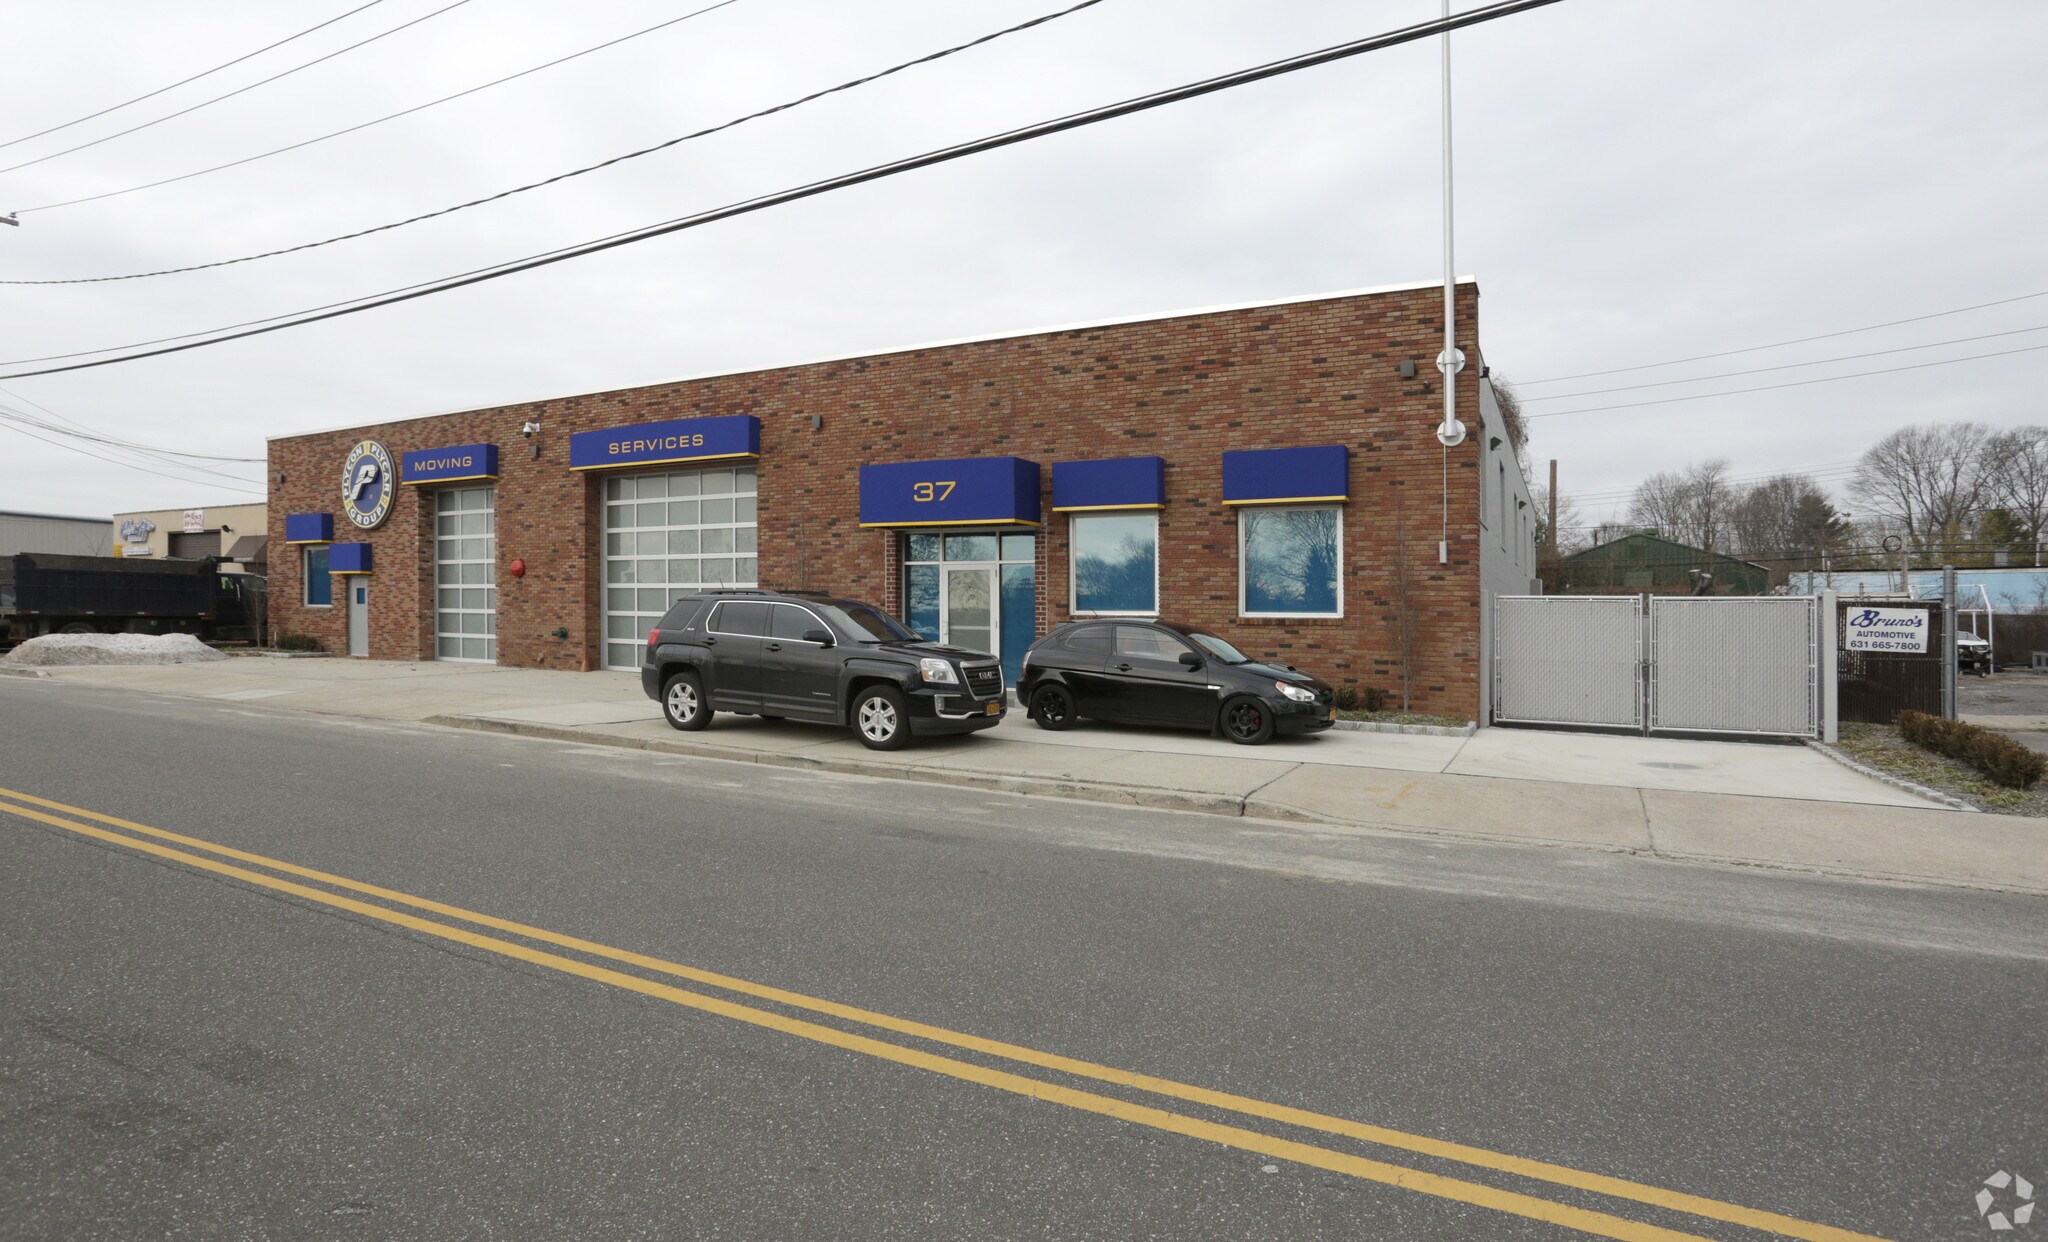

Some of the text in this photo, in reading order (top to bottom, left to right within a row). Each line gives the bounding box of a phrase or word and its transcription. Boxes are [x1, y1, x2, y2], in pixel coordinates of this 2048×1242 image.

[608, 433, 704, 455] SERVICES
[343, 446, 363, 497] PLYCON
[371, 444, 390, 493] PLYCAR
[414, 456, 472, 472] MOVING
[913, 481, 957, 502] 37
[350, 506, 383, 525] GROUP
[1850, 609, 1924, 628] Bruno's
[1856, 630, 1916, 640] AUTOMOTIVE
[1850, 640, 1921, 651] 631 665-7800
